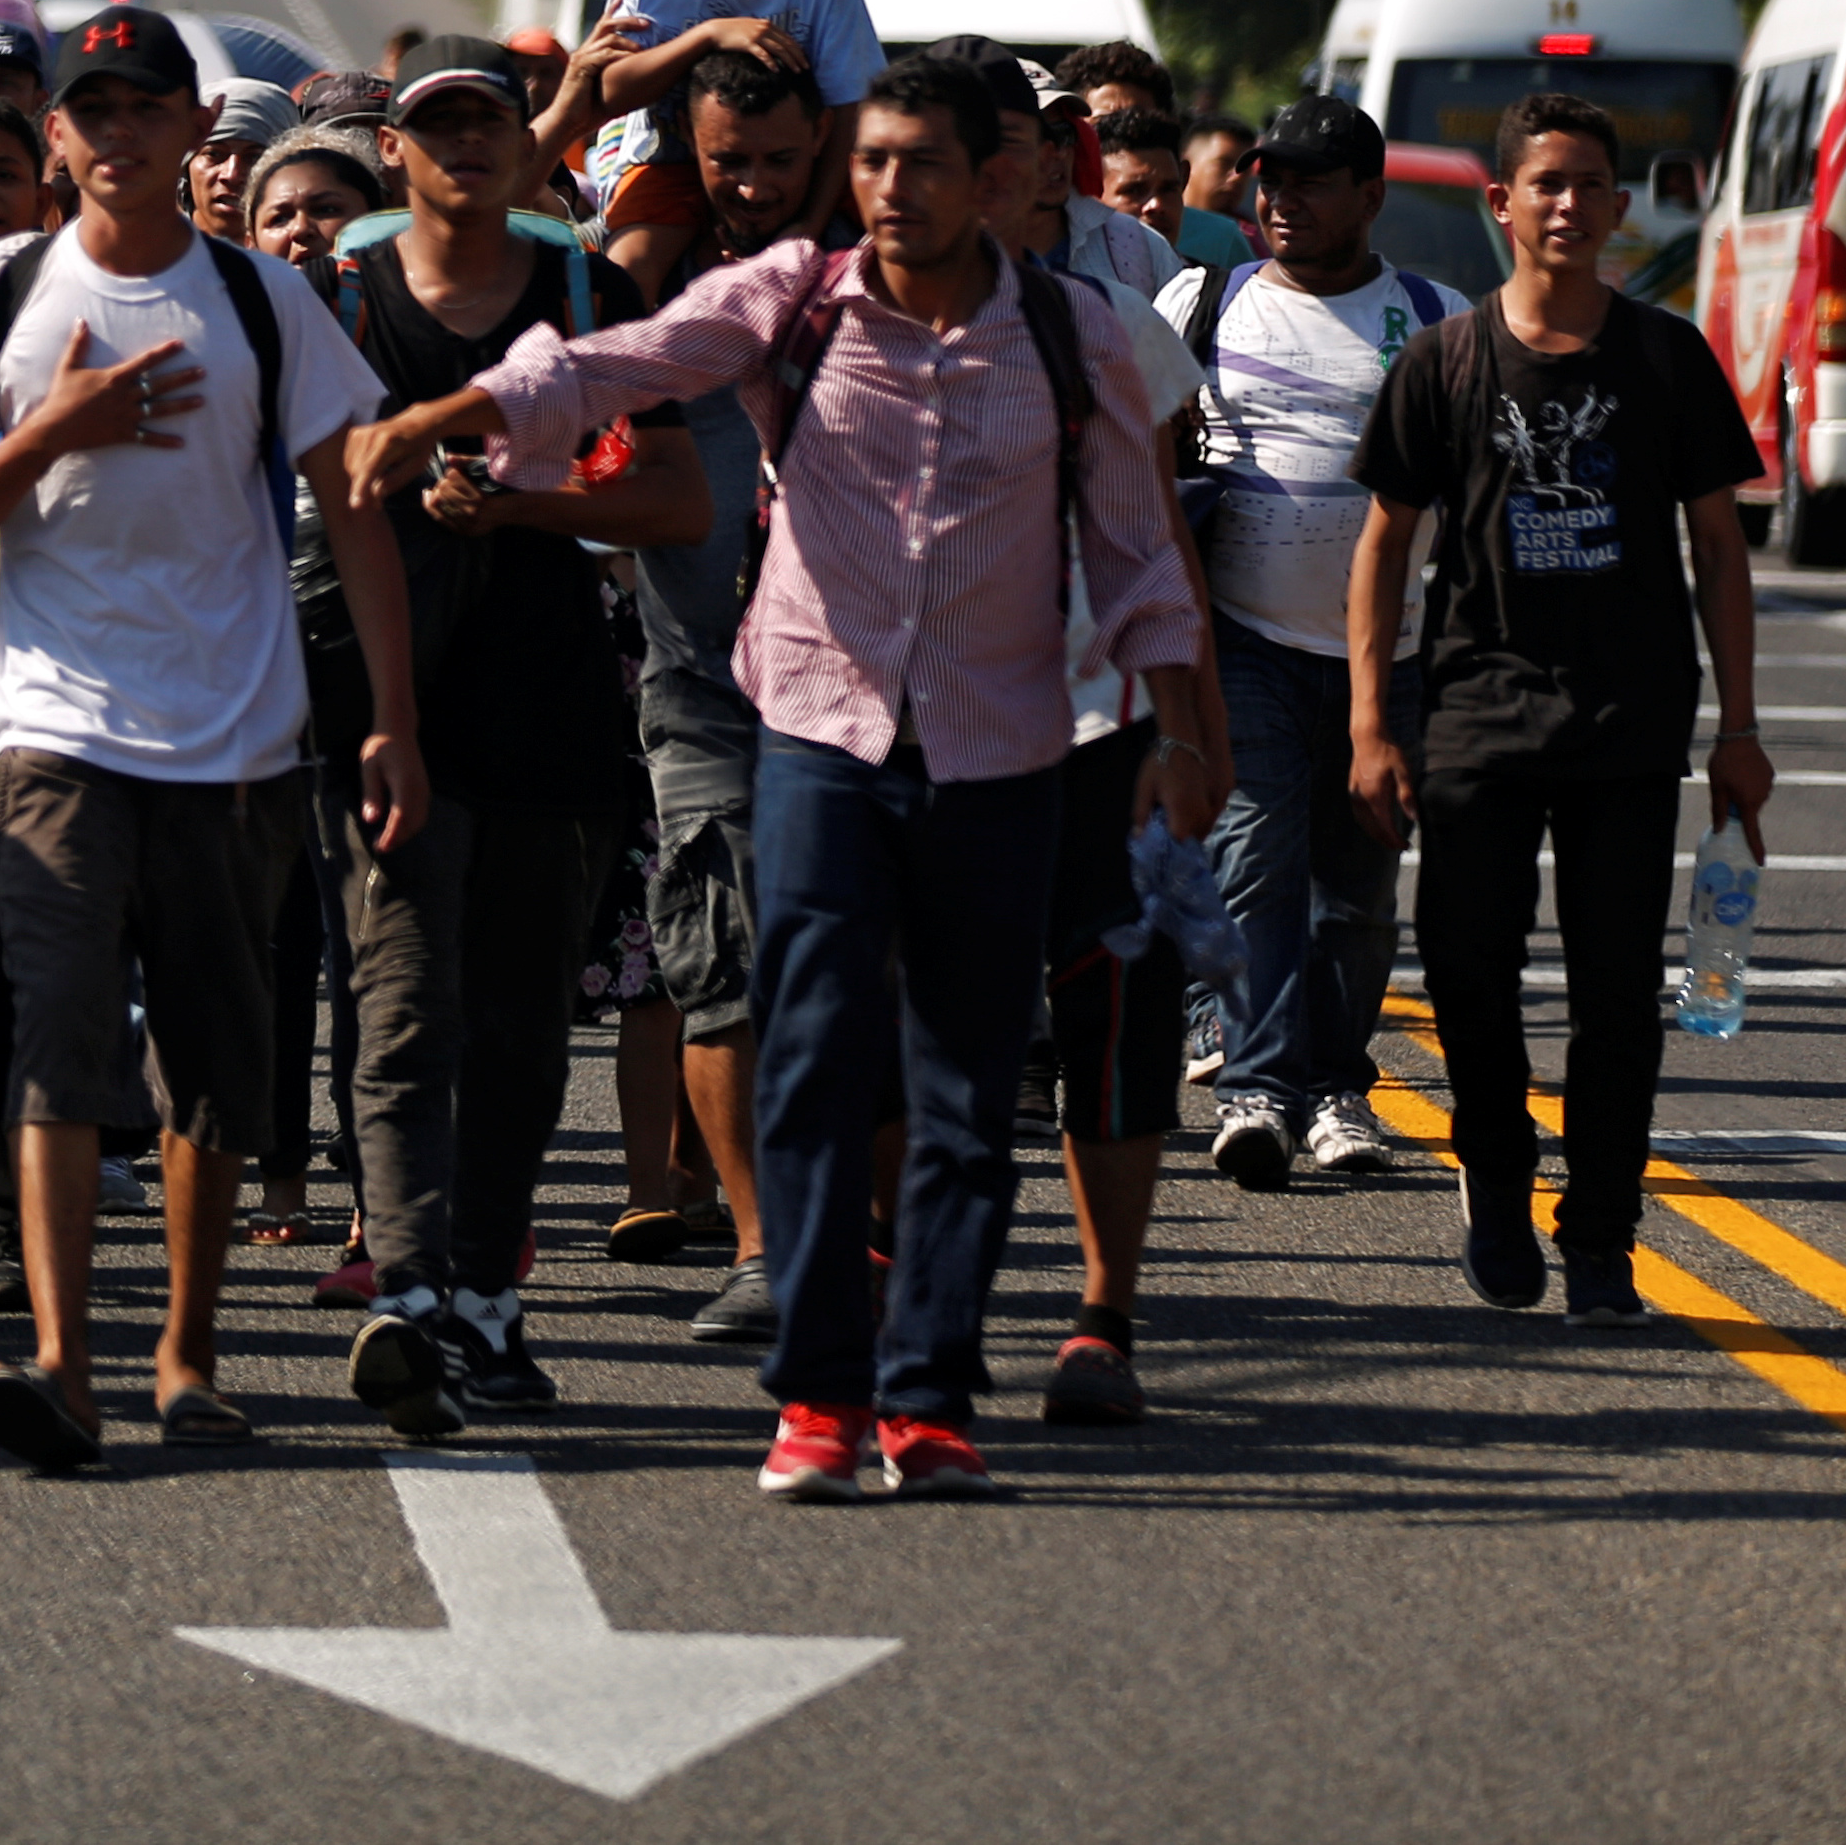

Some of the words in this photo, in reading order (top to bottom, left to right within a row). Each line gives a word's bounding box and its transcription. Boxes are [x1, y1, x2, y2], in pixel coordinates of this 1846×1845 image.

[1510, 505, 1613, 531] COMEDY
[1514, 530, 1577, 550] ARTS
[1515, 543, 1619, 569] FESTIVAL
